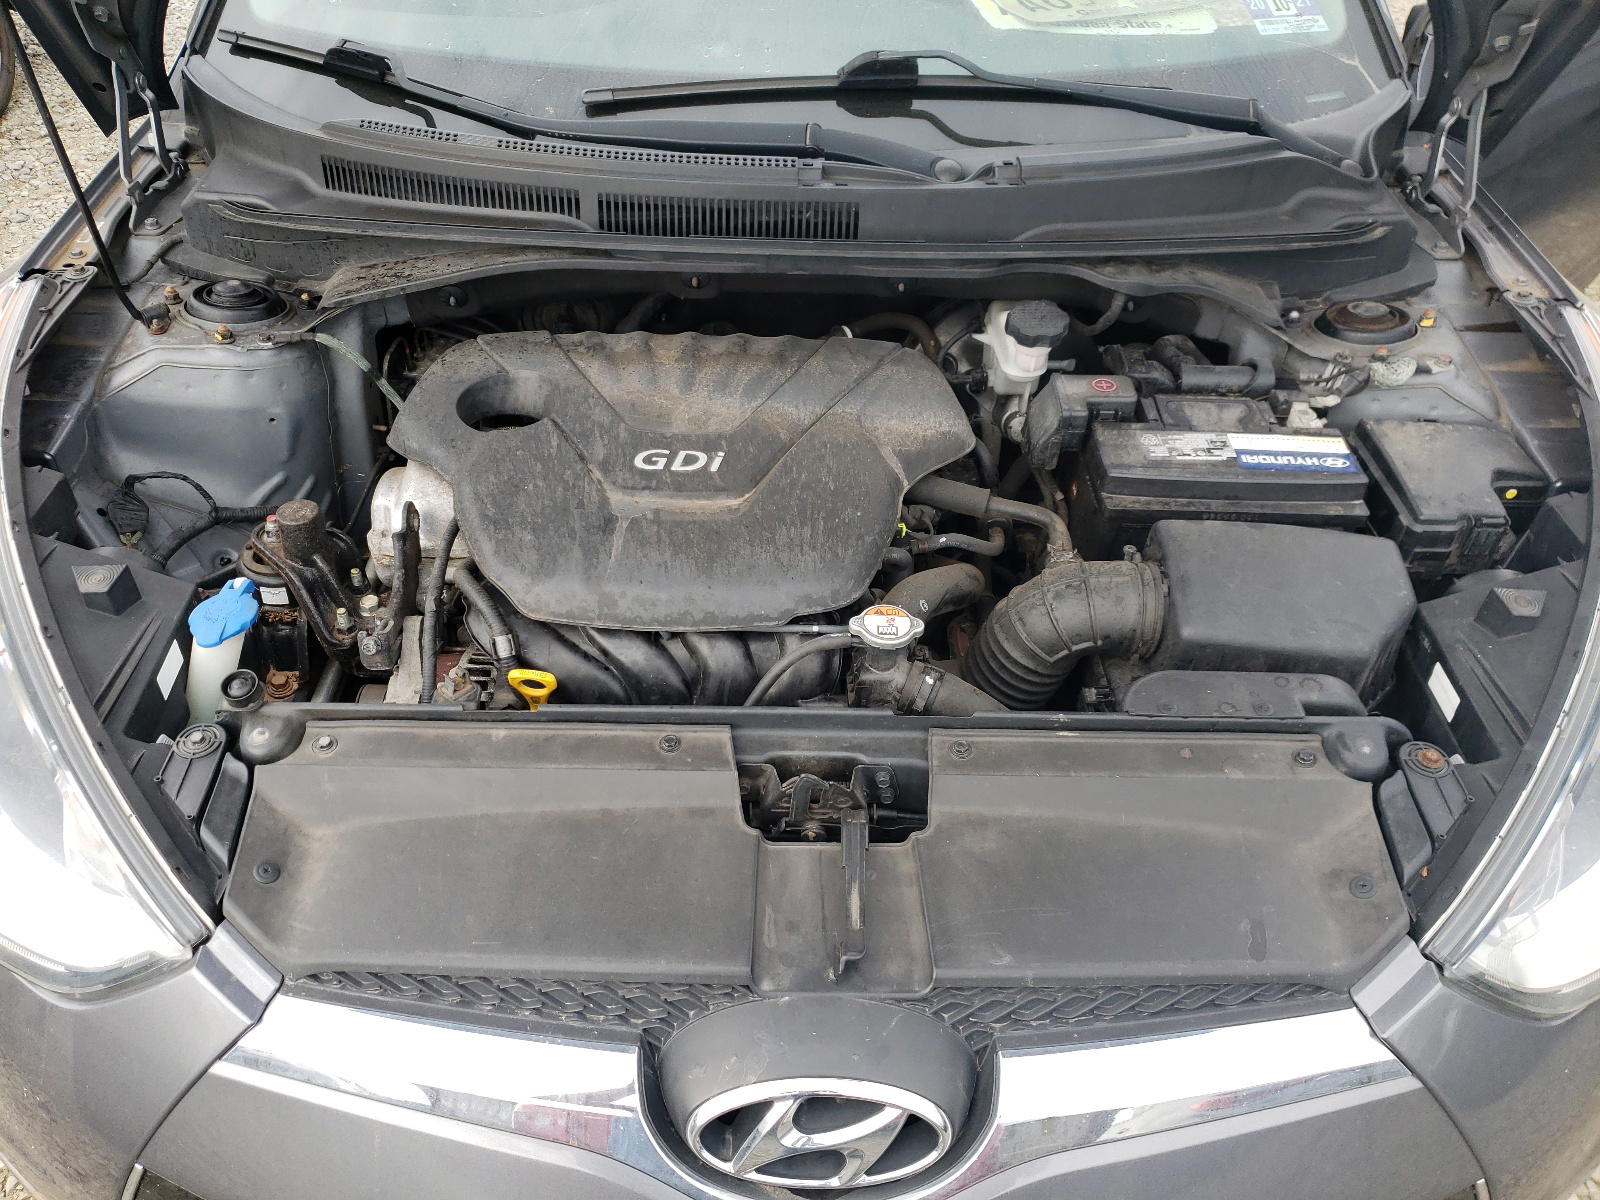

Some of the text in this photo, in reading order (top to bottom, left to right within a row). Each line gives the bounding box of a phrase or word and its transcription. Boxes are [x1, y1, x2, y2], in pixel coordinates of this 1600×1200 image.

[1115, 17, 1162, 29] State
[634, 449, 726, 472] GDi
[1241, 453, 1320, 466] HYUNDAI
